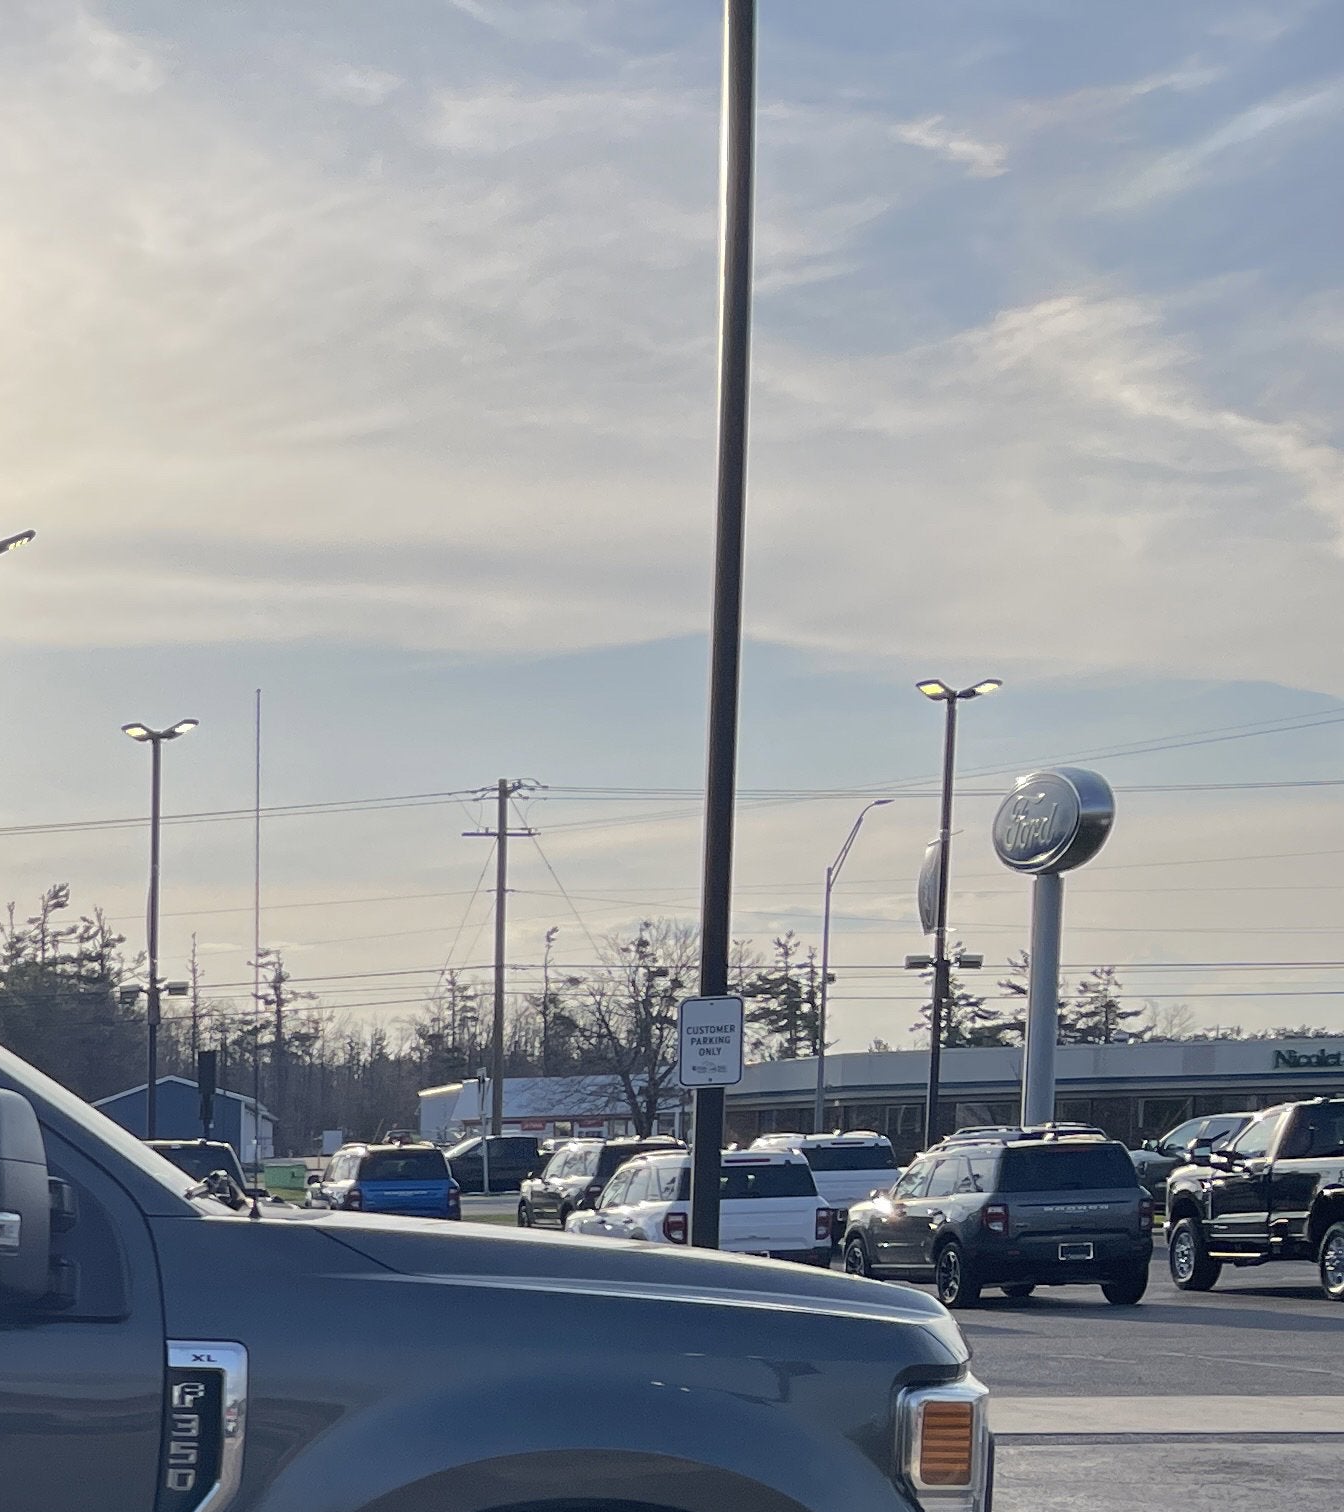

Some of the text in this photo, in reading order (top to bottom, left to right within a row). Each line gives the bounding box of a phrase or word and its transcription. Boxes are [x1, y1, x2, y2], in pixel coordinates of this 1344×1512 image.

[1005, 792, 1059, 853] Ford
[686, 1024, 736, 1035] CUSTOMER
[690, 1036, 731, 1046] PARKING
[698, 1047, 722, 1056] ONLY
[191, 1353, 217, 1363] XL
